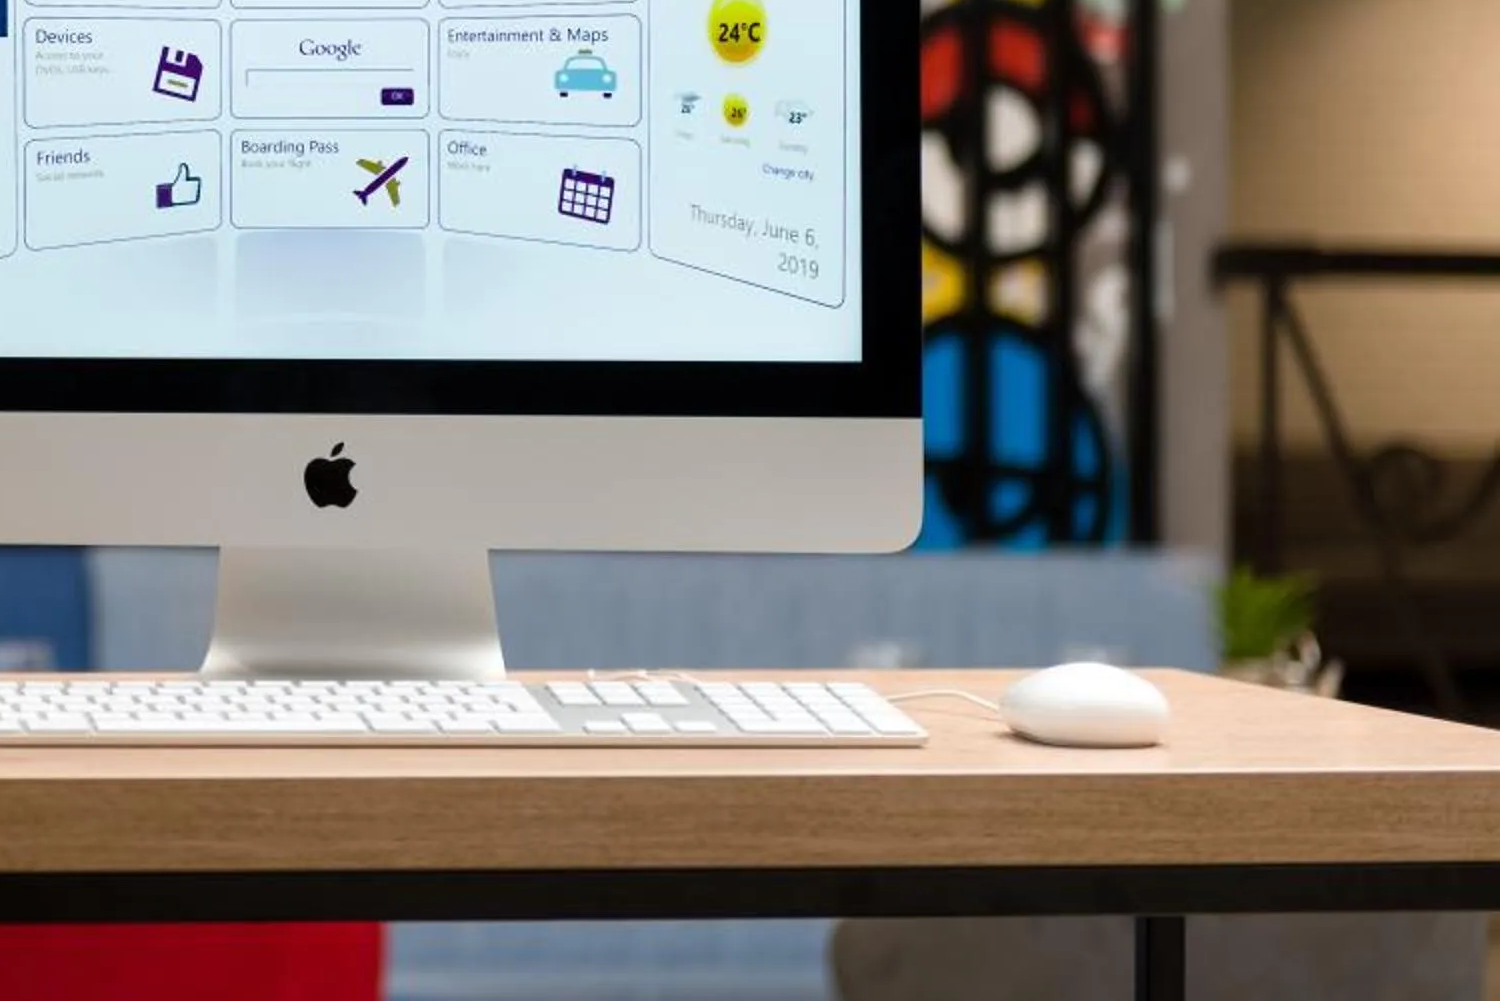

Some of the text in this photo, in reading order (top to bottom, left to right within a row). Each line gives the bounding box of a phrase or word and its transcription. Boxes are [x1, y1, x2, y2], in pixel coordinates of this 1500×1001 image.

[35, 28, 93, 45] Devices
[447, 27, 610, 46] Entertainment & Maps
[718, 21, 761, 43] 24°C
[299, 38, 362, 62] Google
[36, 147, 92, 166] Friends
[240, 139, 340, 156] Boarding Pass
[447, 139, 488, 157] Office
[761, 162, 815, 182] Change city
[690, 203, 820, 250] Thursday, June 6,
[776, 251, 820, 281] 2019
